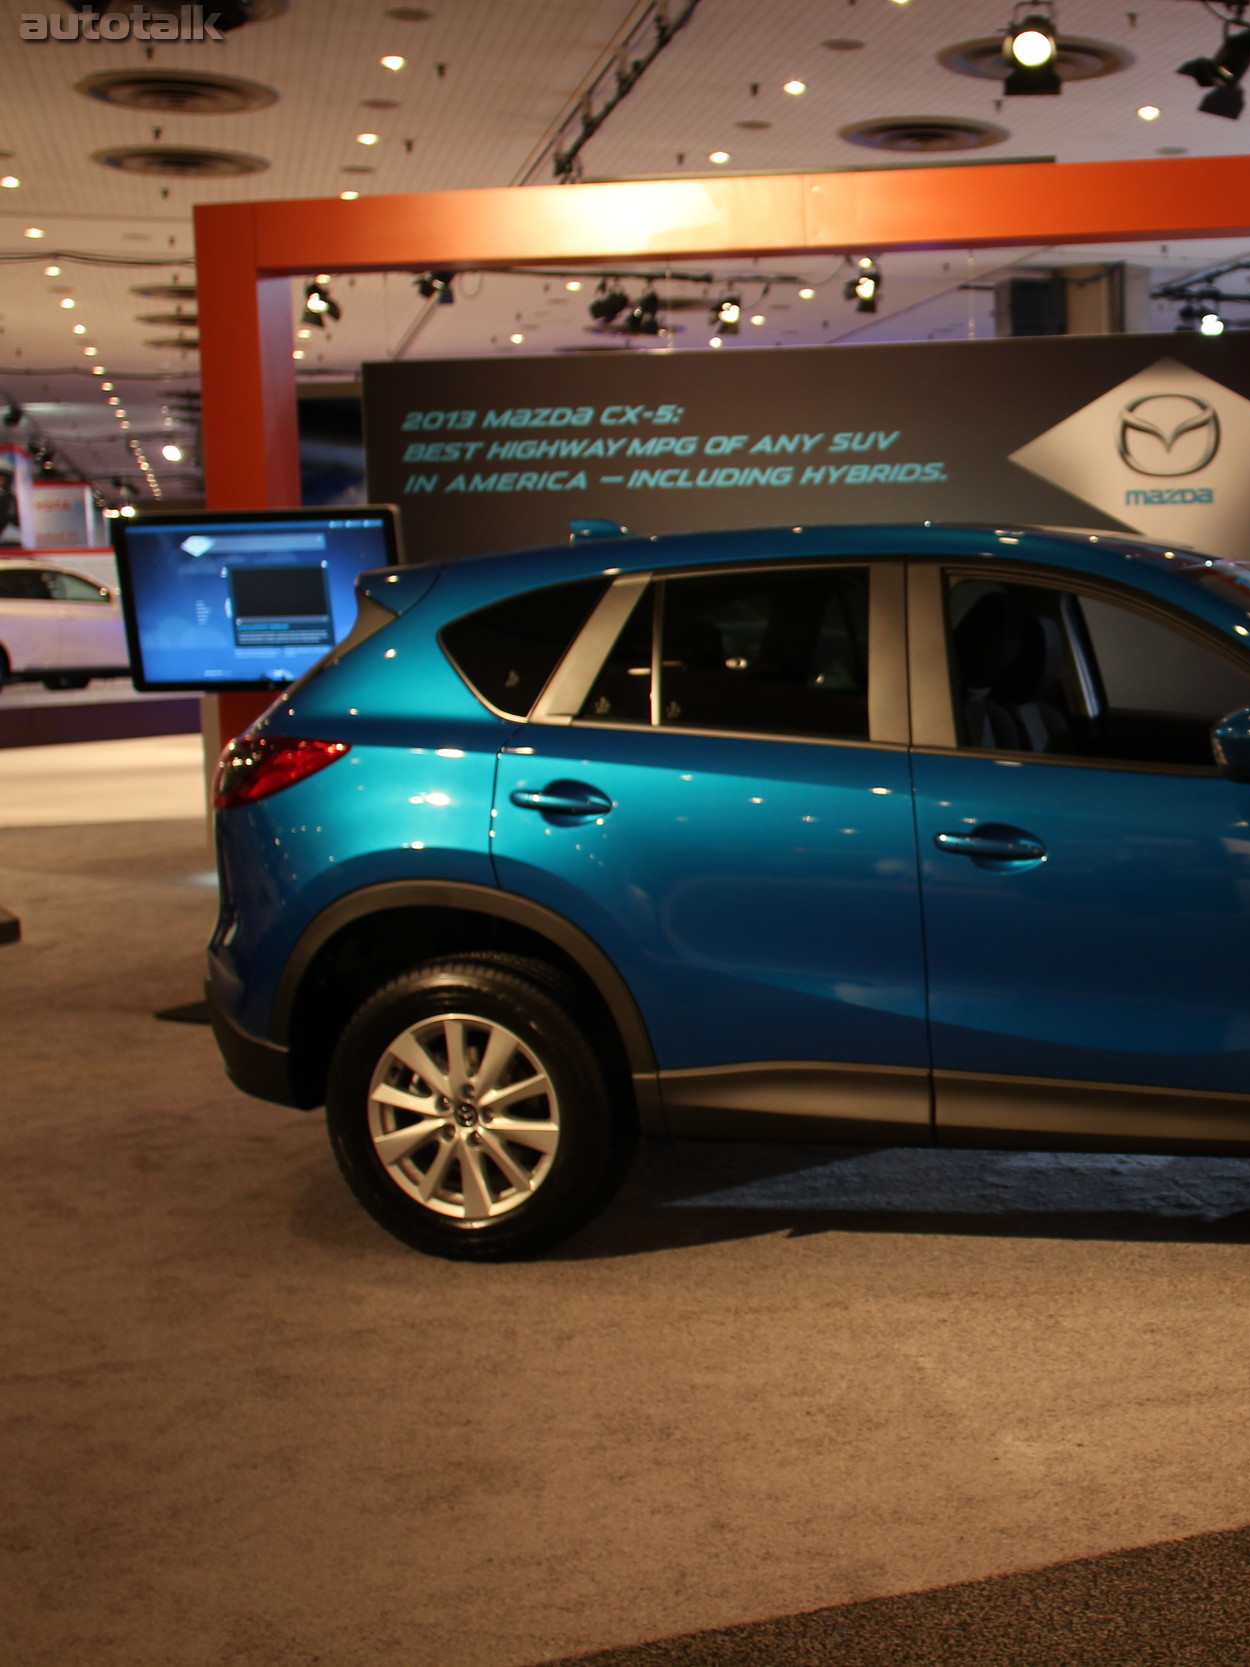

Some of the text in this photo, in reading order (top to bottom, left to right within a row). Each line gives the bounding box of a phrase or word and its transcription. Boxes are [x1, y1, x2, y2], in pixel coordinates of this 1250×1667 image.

[401, 410, 477, 431] 2013
[600, 404, 685, 426] CX-5:
[402, 430, 900, 462] BEST HIGHWAY MPG OF ANY SUV
[404, 474, 439, 494] IN
[444, 470, 588, 493] AMERICA
[799, 461, 948, 486] HYBRIDS.
